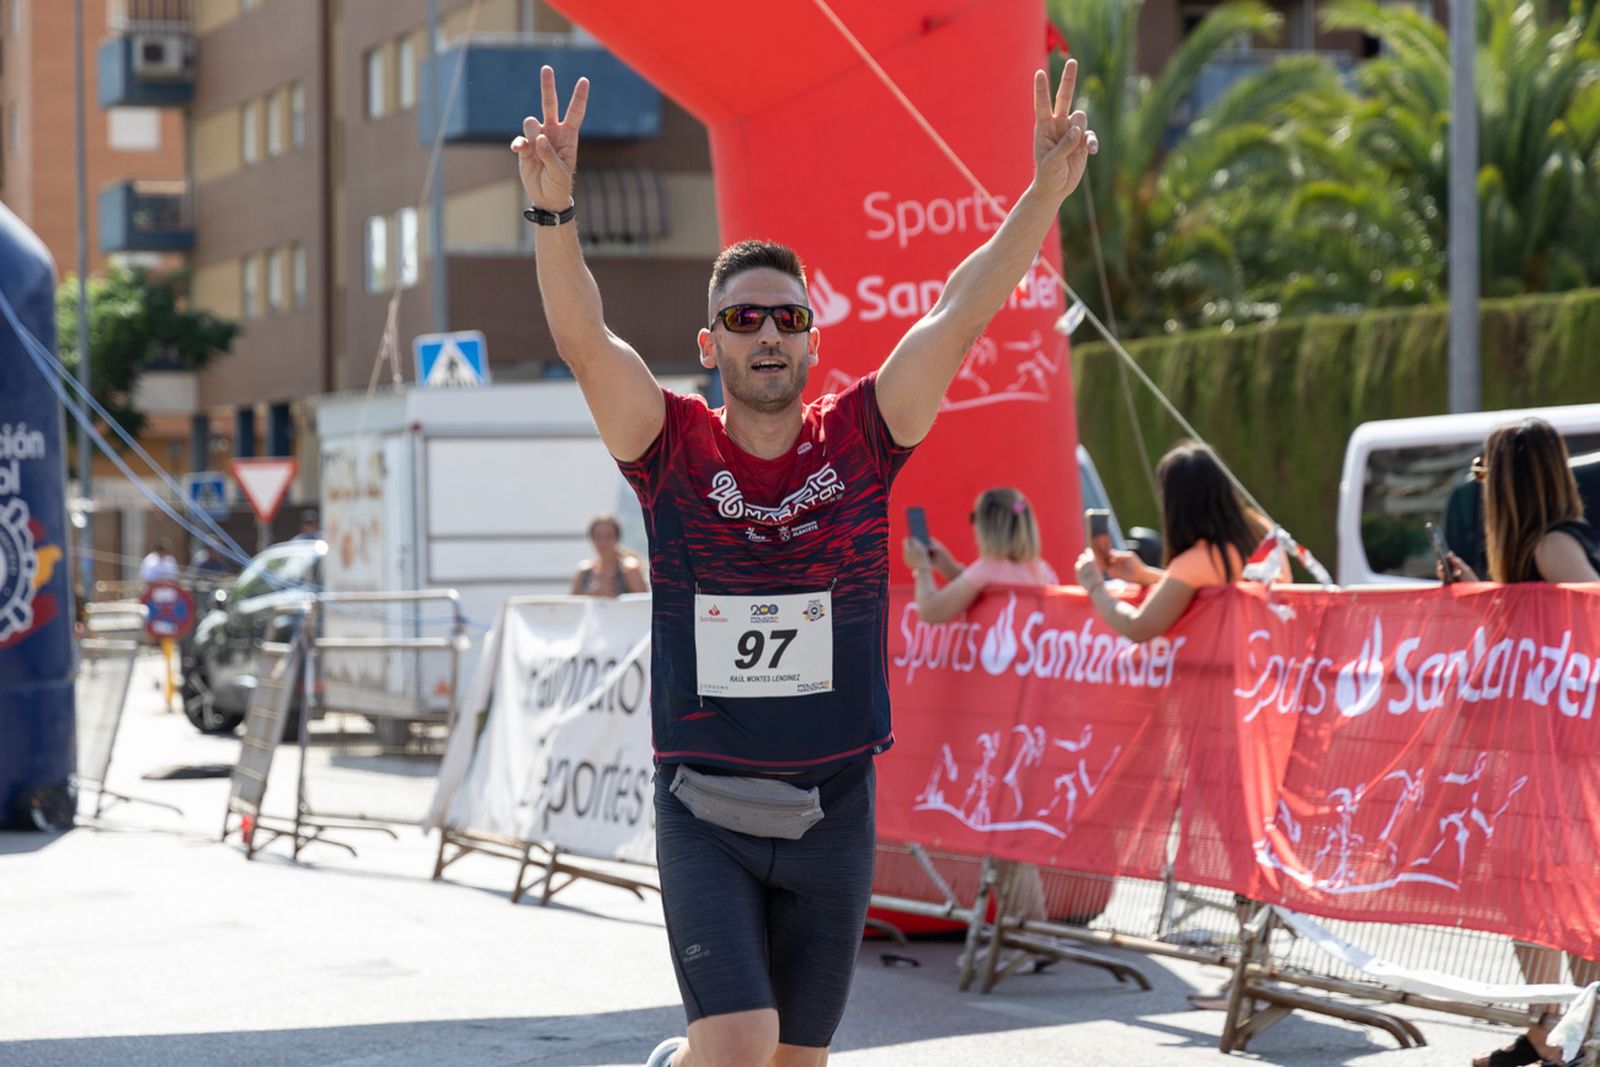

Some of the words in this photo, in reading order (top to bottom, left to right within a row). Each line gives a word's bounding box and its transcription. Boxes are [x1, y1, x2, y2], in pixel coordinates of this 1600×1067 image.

[857, 263, 1058, 321] Sander
[707, 470, 744, 518] 26
[734, 629, 798, 670] 97
[746, 675, 771, 683] MONTES
[541, 747, 650, 832] portes
